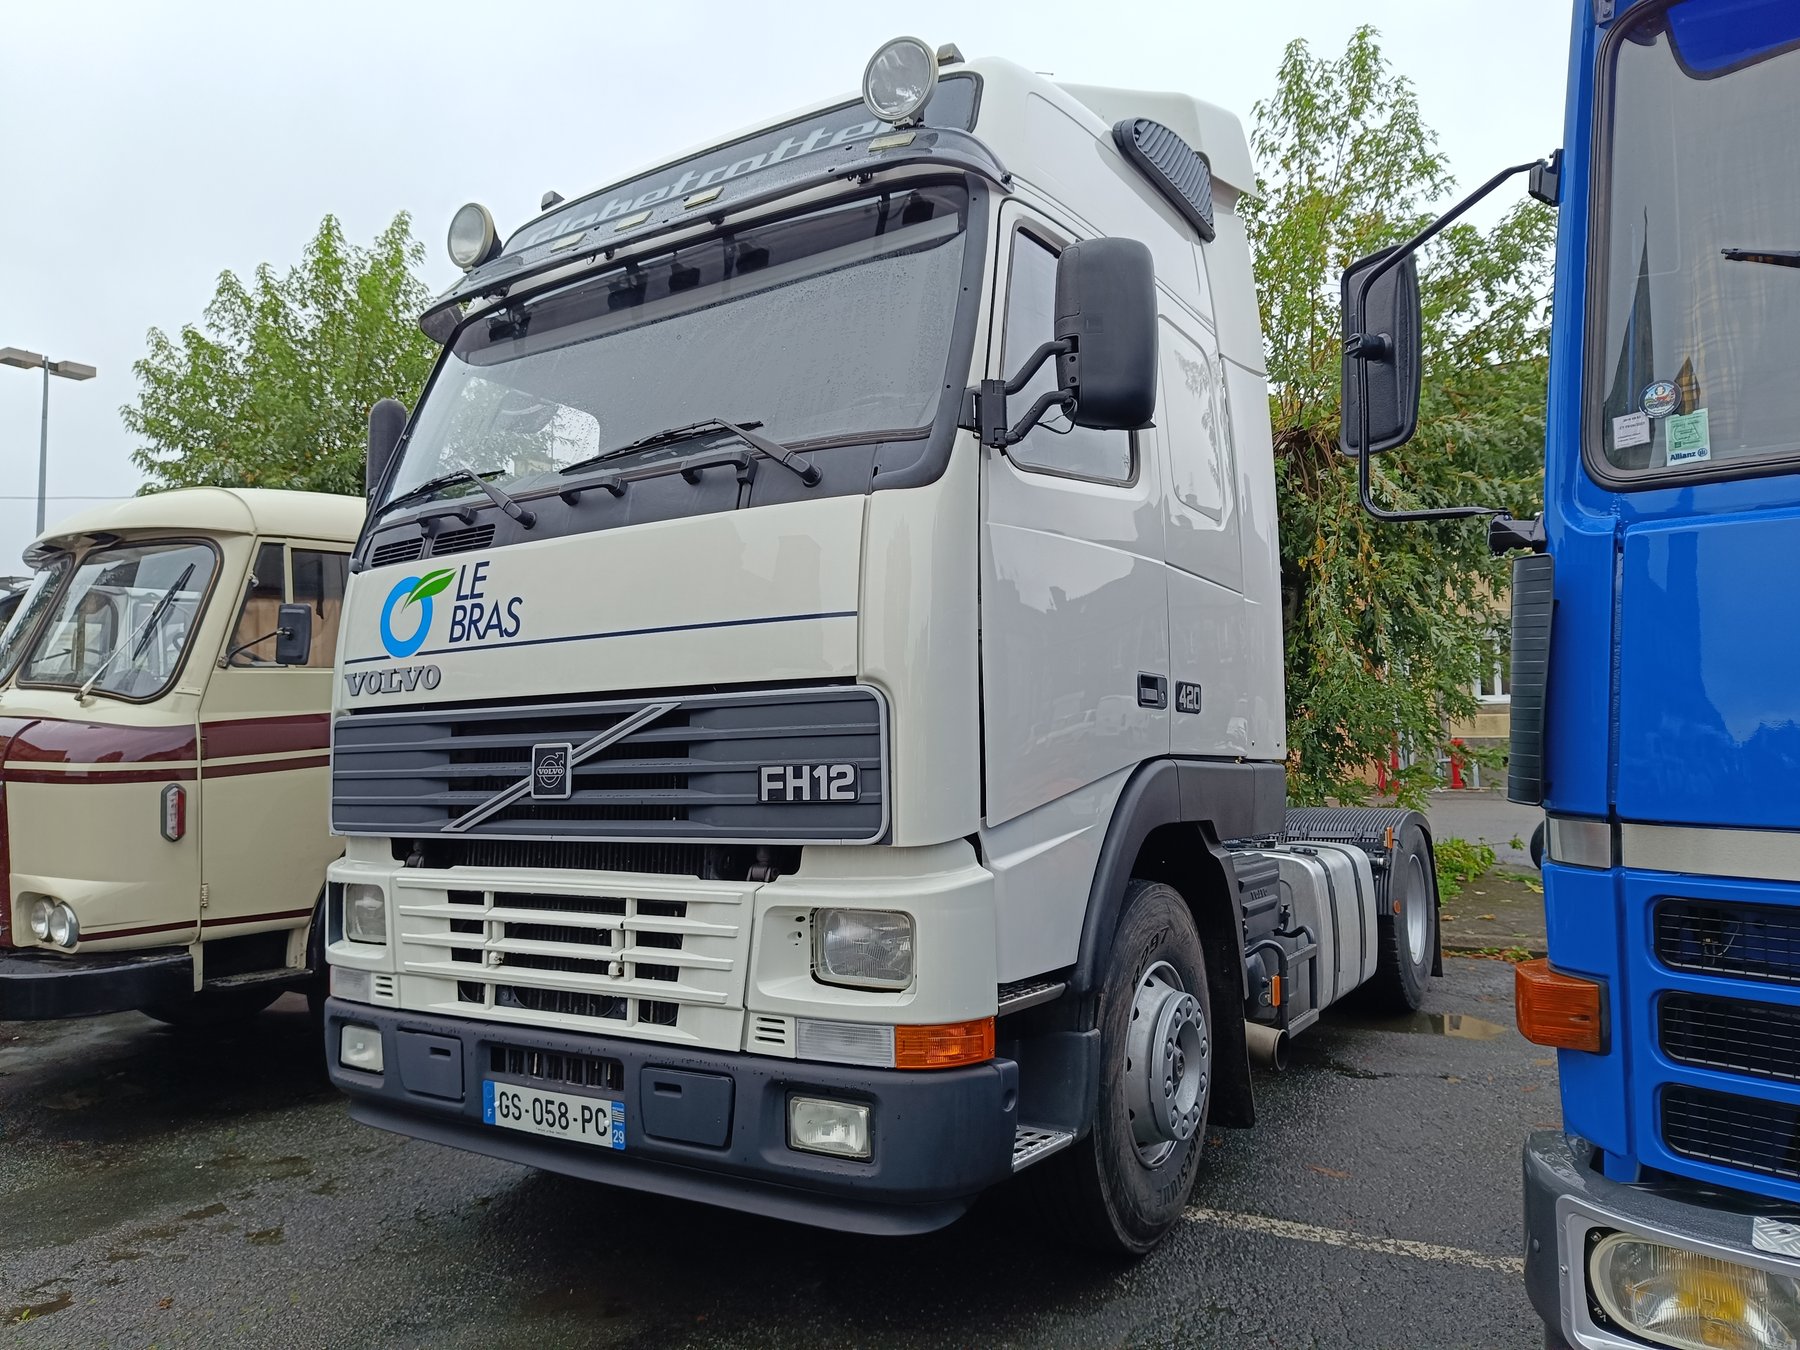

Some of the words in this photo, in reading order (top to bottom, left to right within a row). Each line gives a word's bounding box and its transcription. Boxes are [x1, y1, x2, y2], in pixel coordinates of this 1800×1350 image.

[1670, 451, 1697, 461] Allianz
[455, 561, 490, 601] LE
[448, 597, 523, 643] BRAS
[344, 664, 442, 697] VOLVO
[1179, 685, 1201, 709] 420
[761, 765, 855, 800] FH12
[487, 1108, 493, 1118] F
[499, 1091, 608, 1137] GS-058-PC
[613, 1129, 624, 1144] 29
